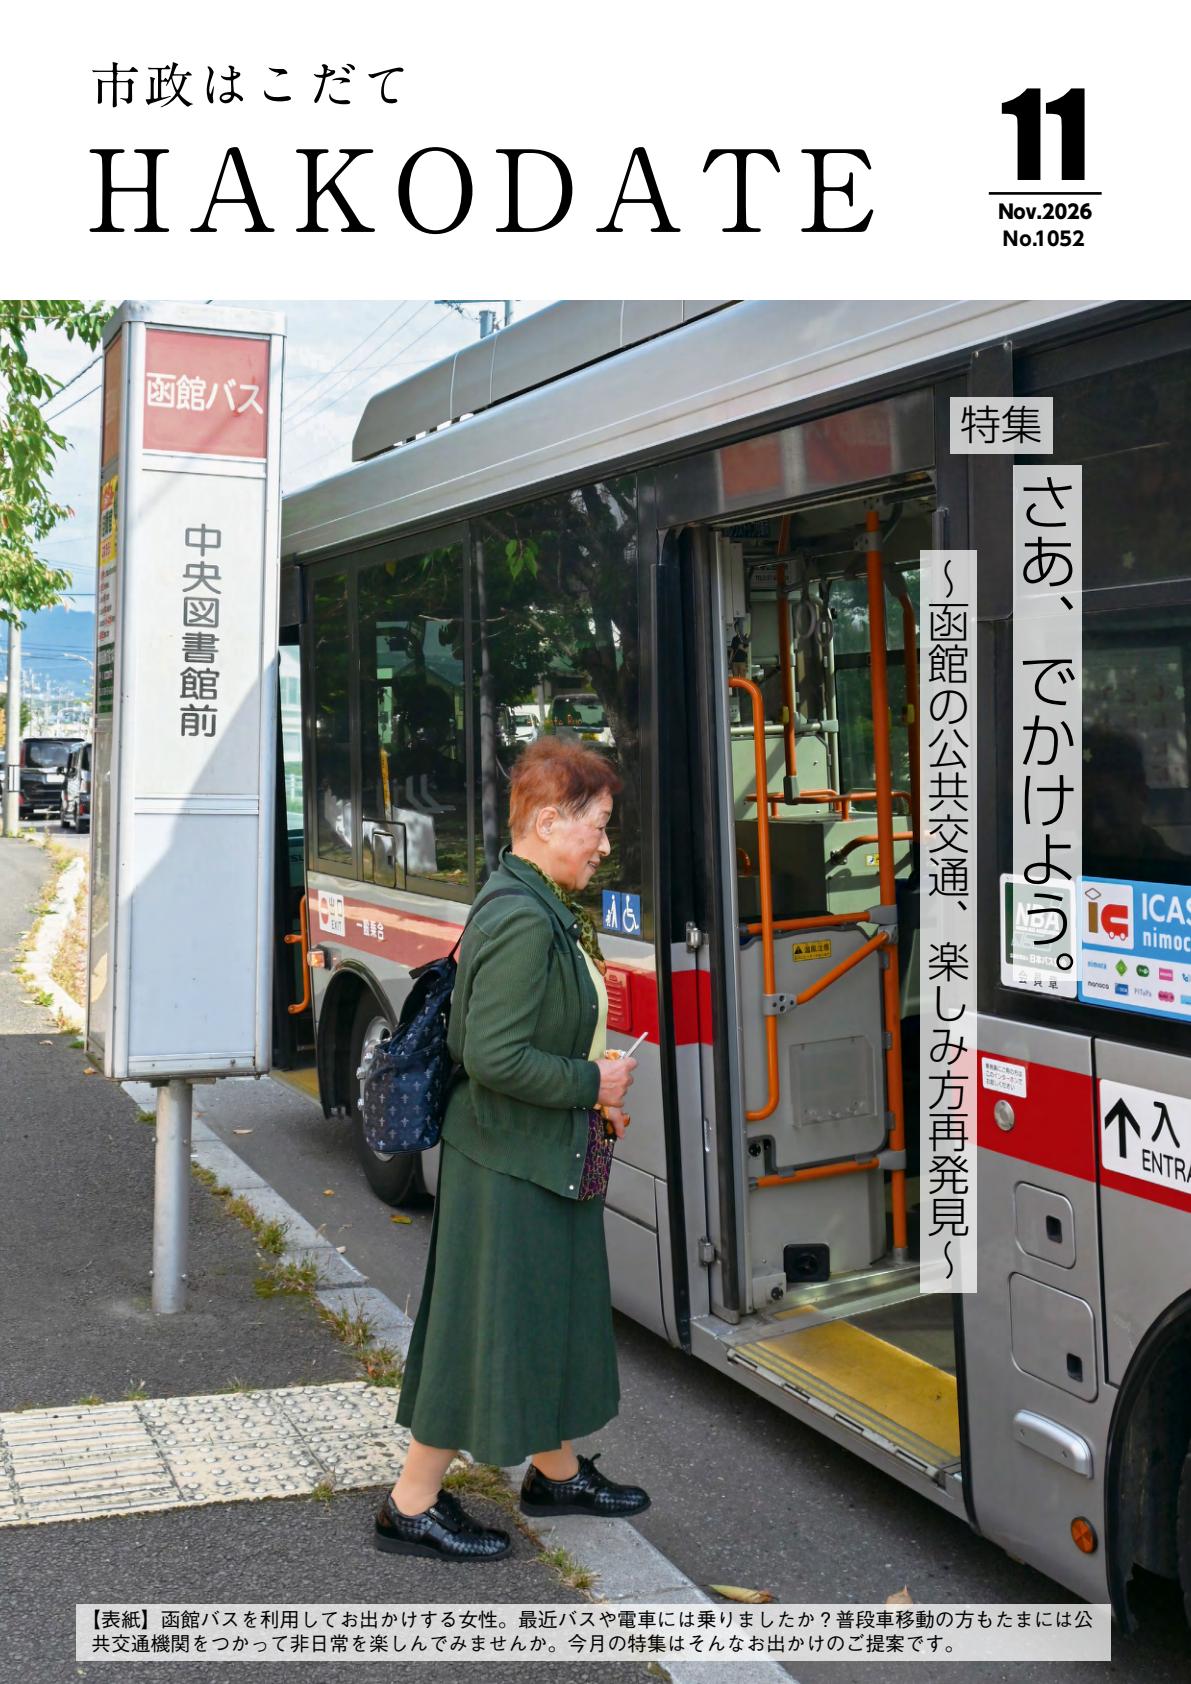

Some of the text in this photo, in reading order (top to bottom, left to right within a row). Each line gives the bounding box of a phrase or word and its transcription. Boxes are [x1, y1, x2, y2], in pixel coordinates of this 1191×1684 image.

[145, 371, 264, 416] 函館バス
[179, 522, 223, 738] 中央図書館前
